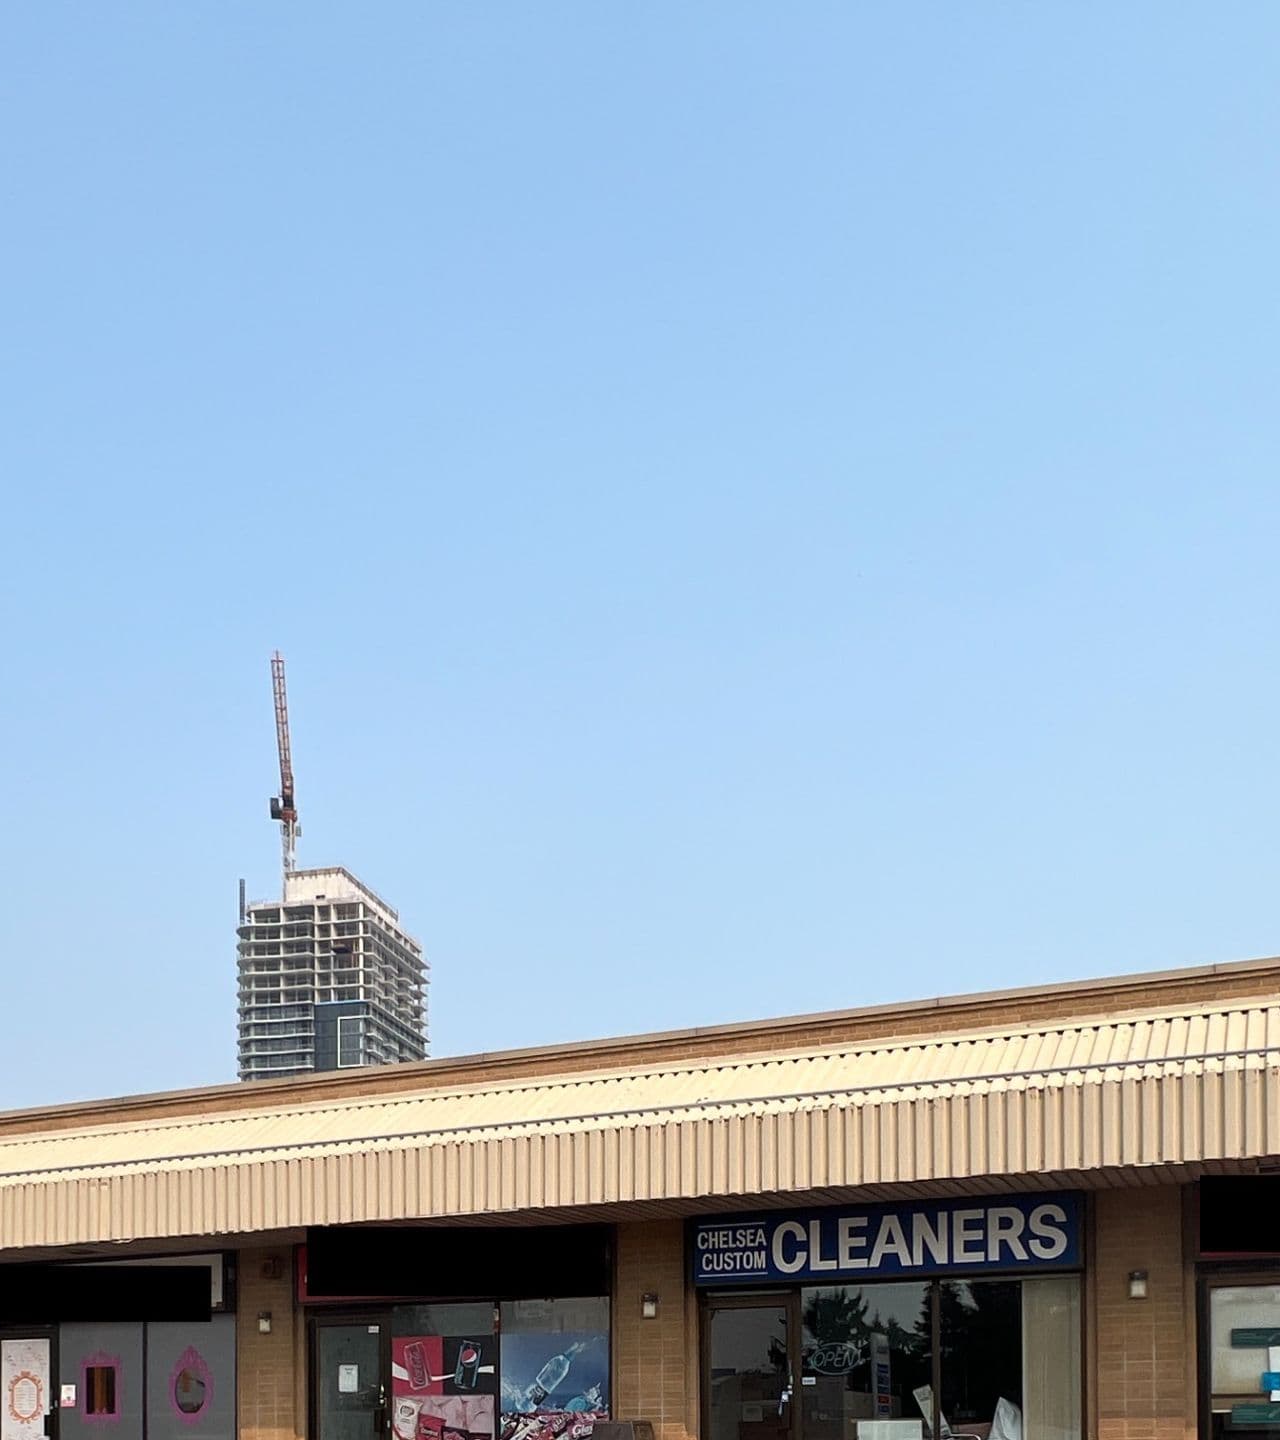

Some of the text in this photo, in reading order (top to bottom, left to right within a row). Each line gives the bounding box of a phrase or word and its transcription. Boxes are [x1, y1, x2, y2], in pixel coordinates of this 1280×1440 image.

[697, 1227, 767, 1250] CHELSEA
[771, 1203, 1068, 1274] CLEANERS
[702, 1250, 766, 1271] CUSTOM
[813, 1351, 856, 1368] OPEN
